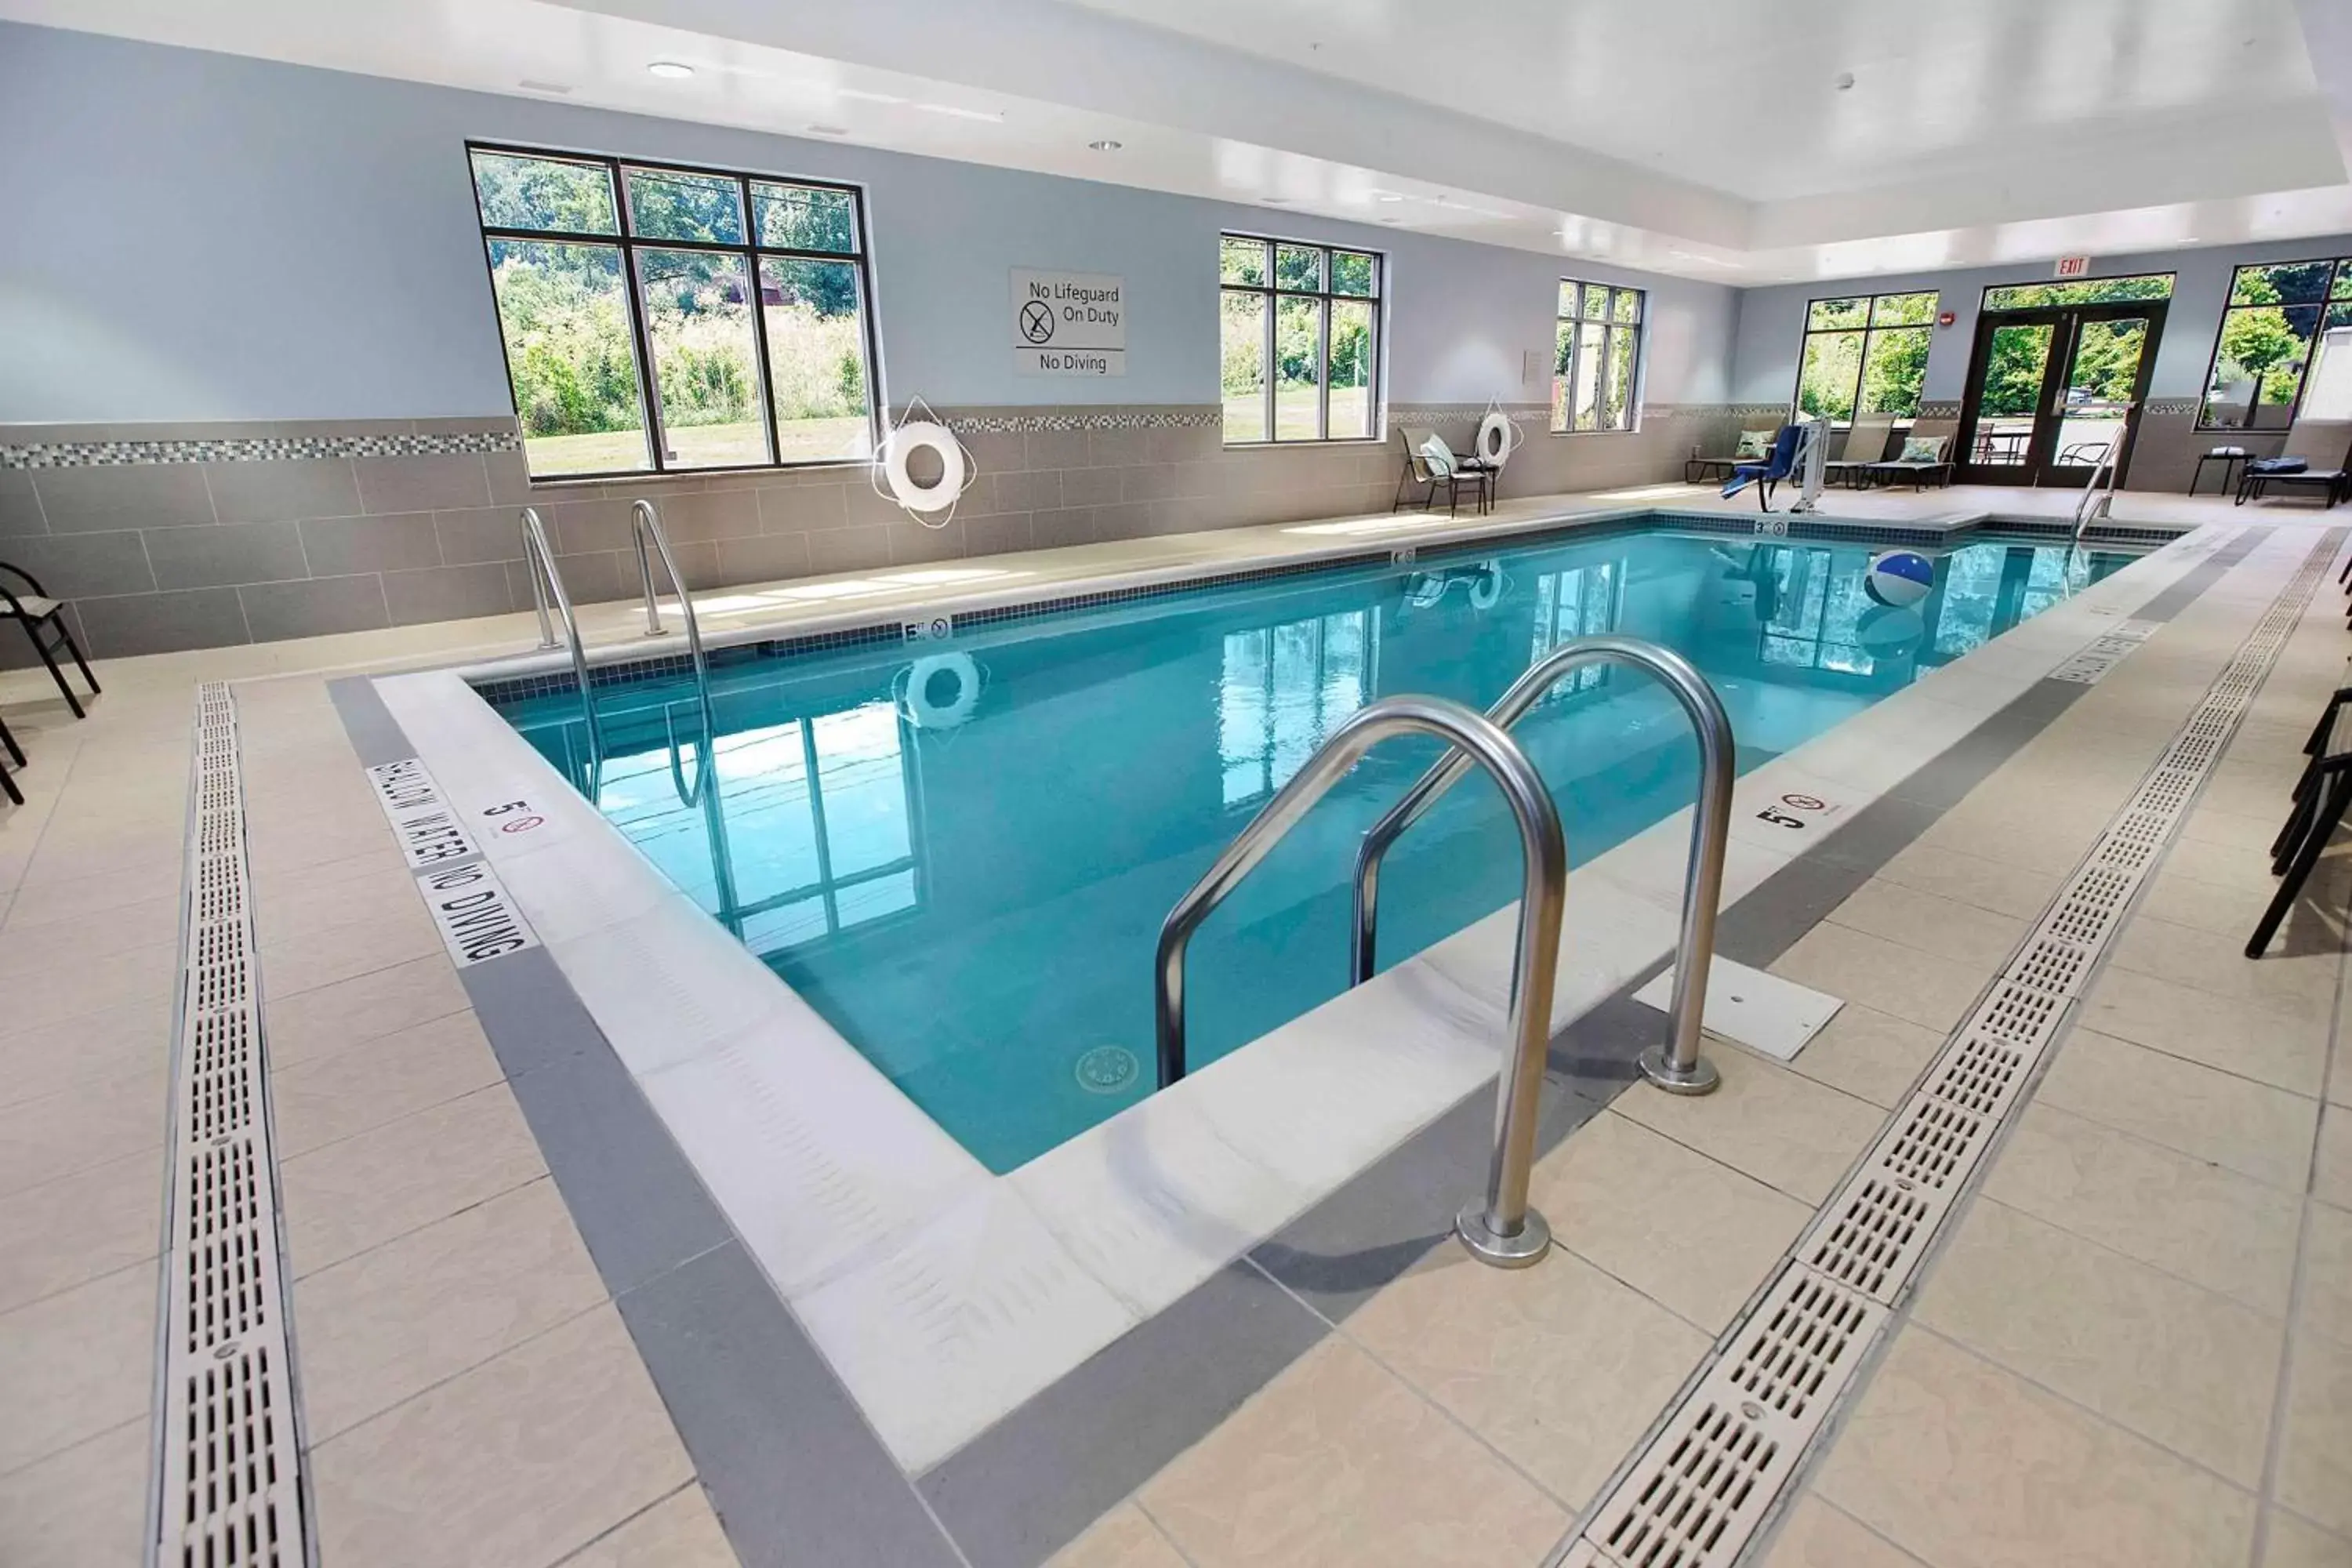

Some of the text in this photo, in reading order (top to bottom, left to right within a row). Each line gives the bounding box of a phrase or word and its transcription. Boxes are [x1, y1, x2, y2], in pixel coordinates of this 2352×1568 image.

[2059, 258, 2085, 274] EXIT
[1029, 281, 1119, 305] No Lifeguard
[1063, 307, 1119, 327] On Duty
[1040, 354, 1106, 374] No Diving
[483, 800, 528, 816] 5
[1755, 811, 1805, 829] 5
[401, 811, 469, 865] WATER
[428, 864, 525, 963] NO DIVING
